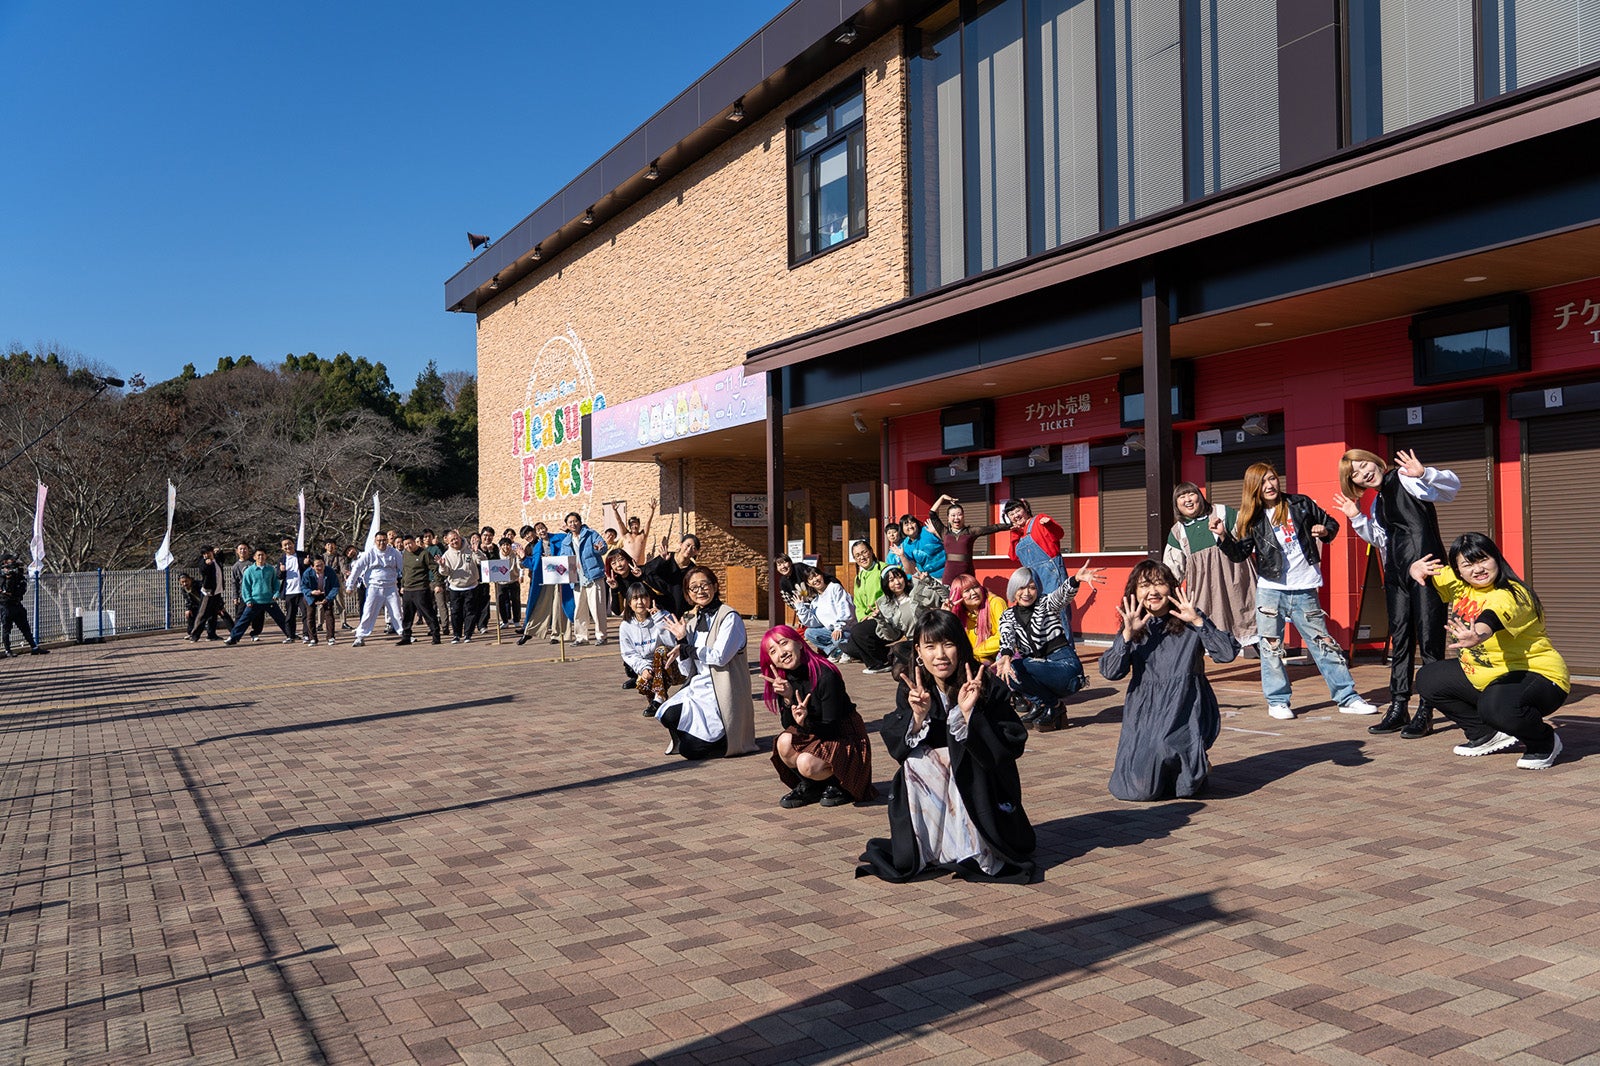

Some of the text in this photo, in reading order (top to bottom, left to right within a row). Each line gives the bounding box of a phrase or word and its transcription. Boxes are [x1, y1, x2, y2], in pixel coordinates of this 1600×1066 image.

[1025, 393, 1091, 421] チケット売場
[1040, 418, 1075, 432] TICKET
[522, 457, 592, 503] Forest
